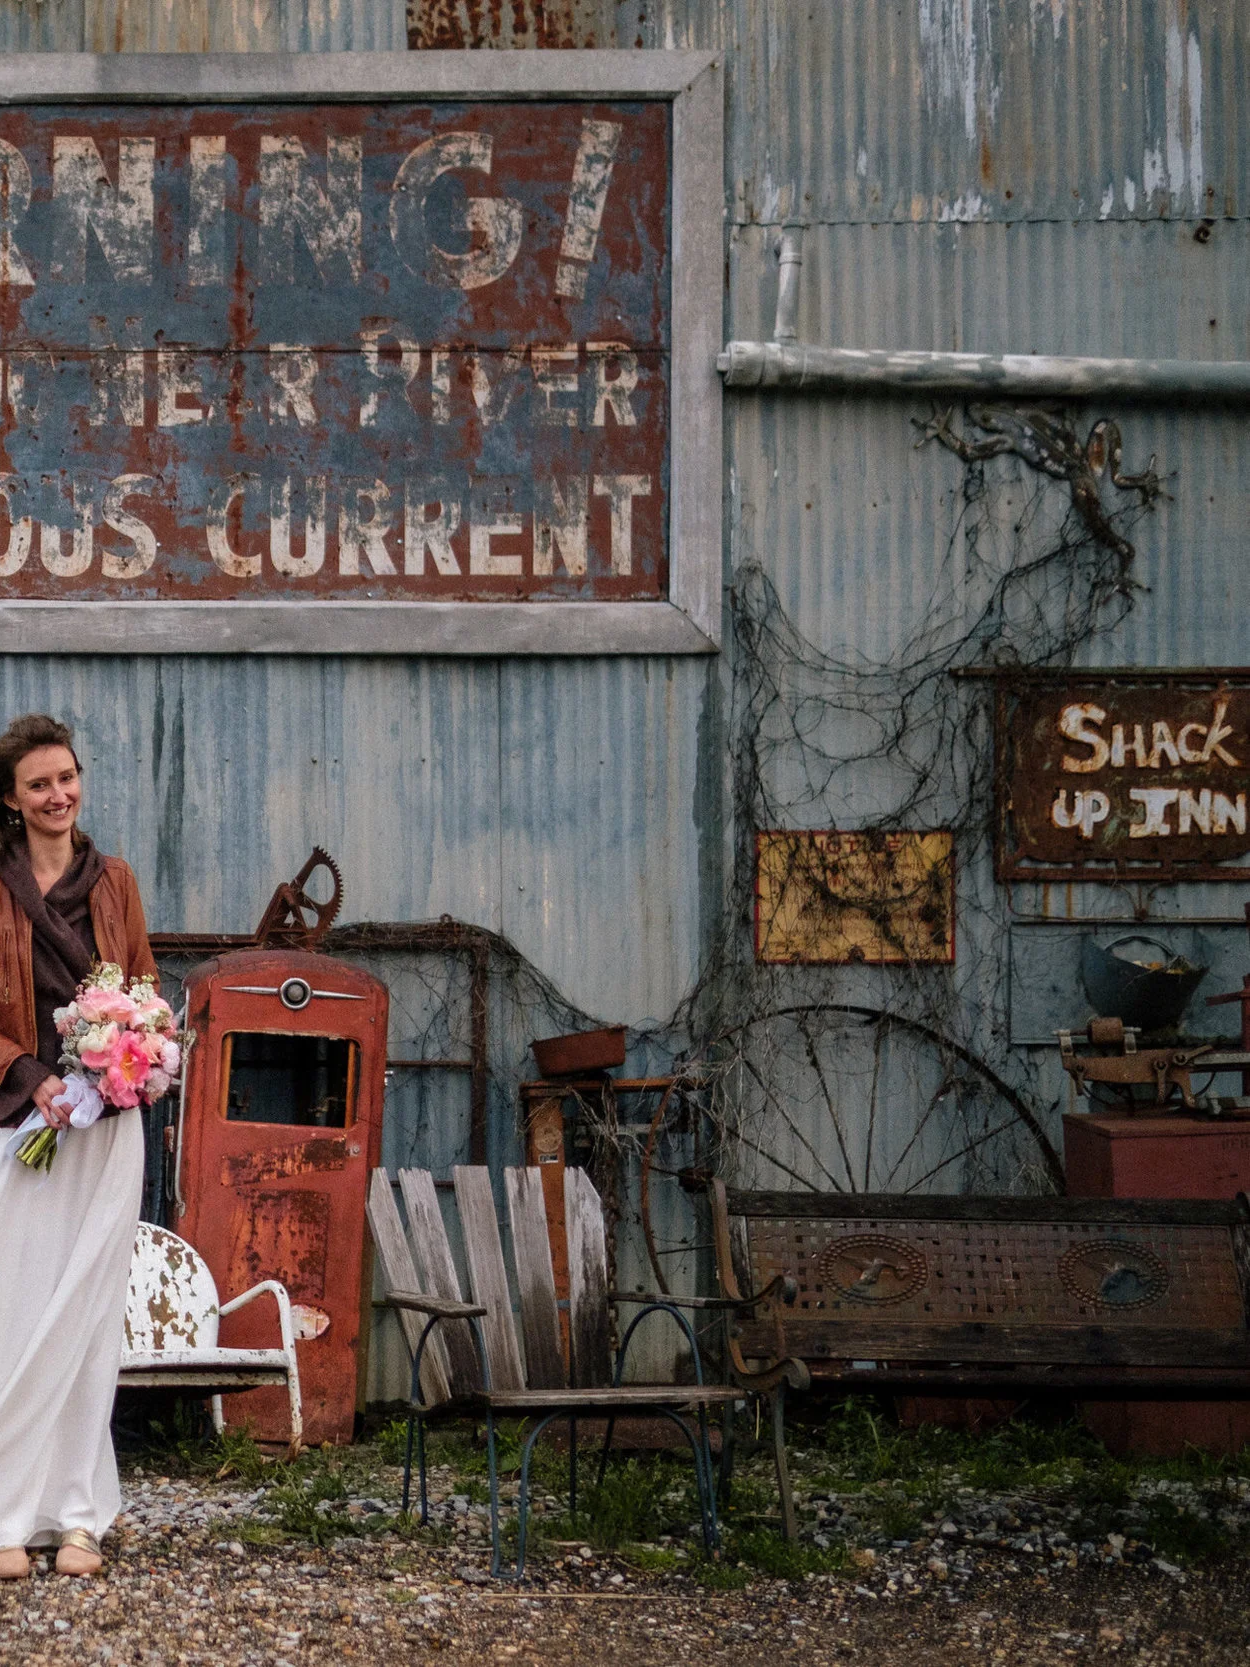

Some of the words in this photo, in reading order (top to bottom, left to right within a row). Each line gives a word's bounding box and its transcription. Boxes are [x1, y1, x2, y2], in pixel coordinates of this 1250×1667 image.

[205, 471, 652, 579] CURRENT
[1058, 695, 1244, 774] SHACK
[1052, 787, 1111, 839] UP
[1128, 787, 1248, 839] INN
